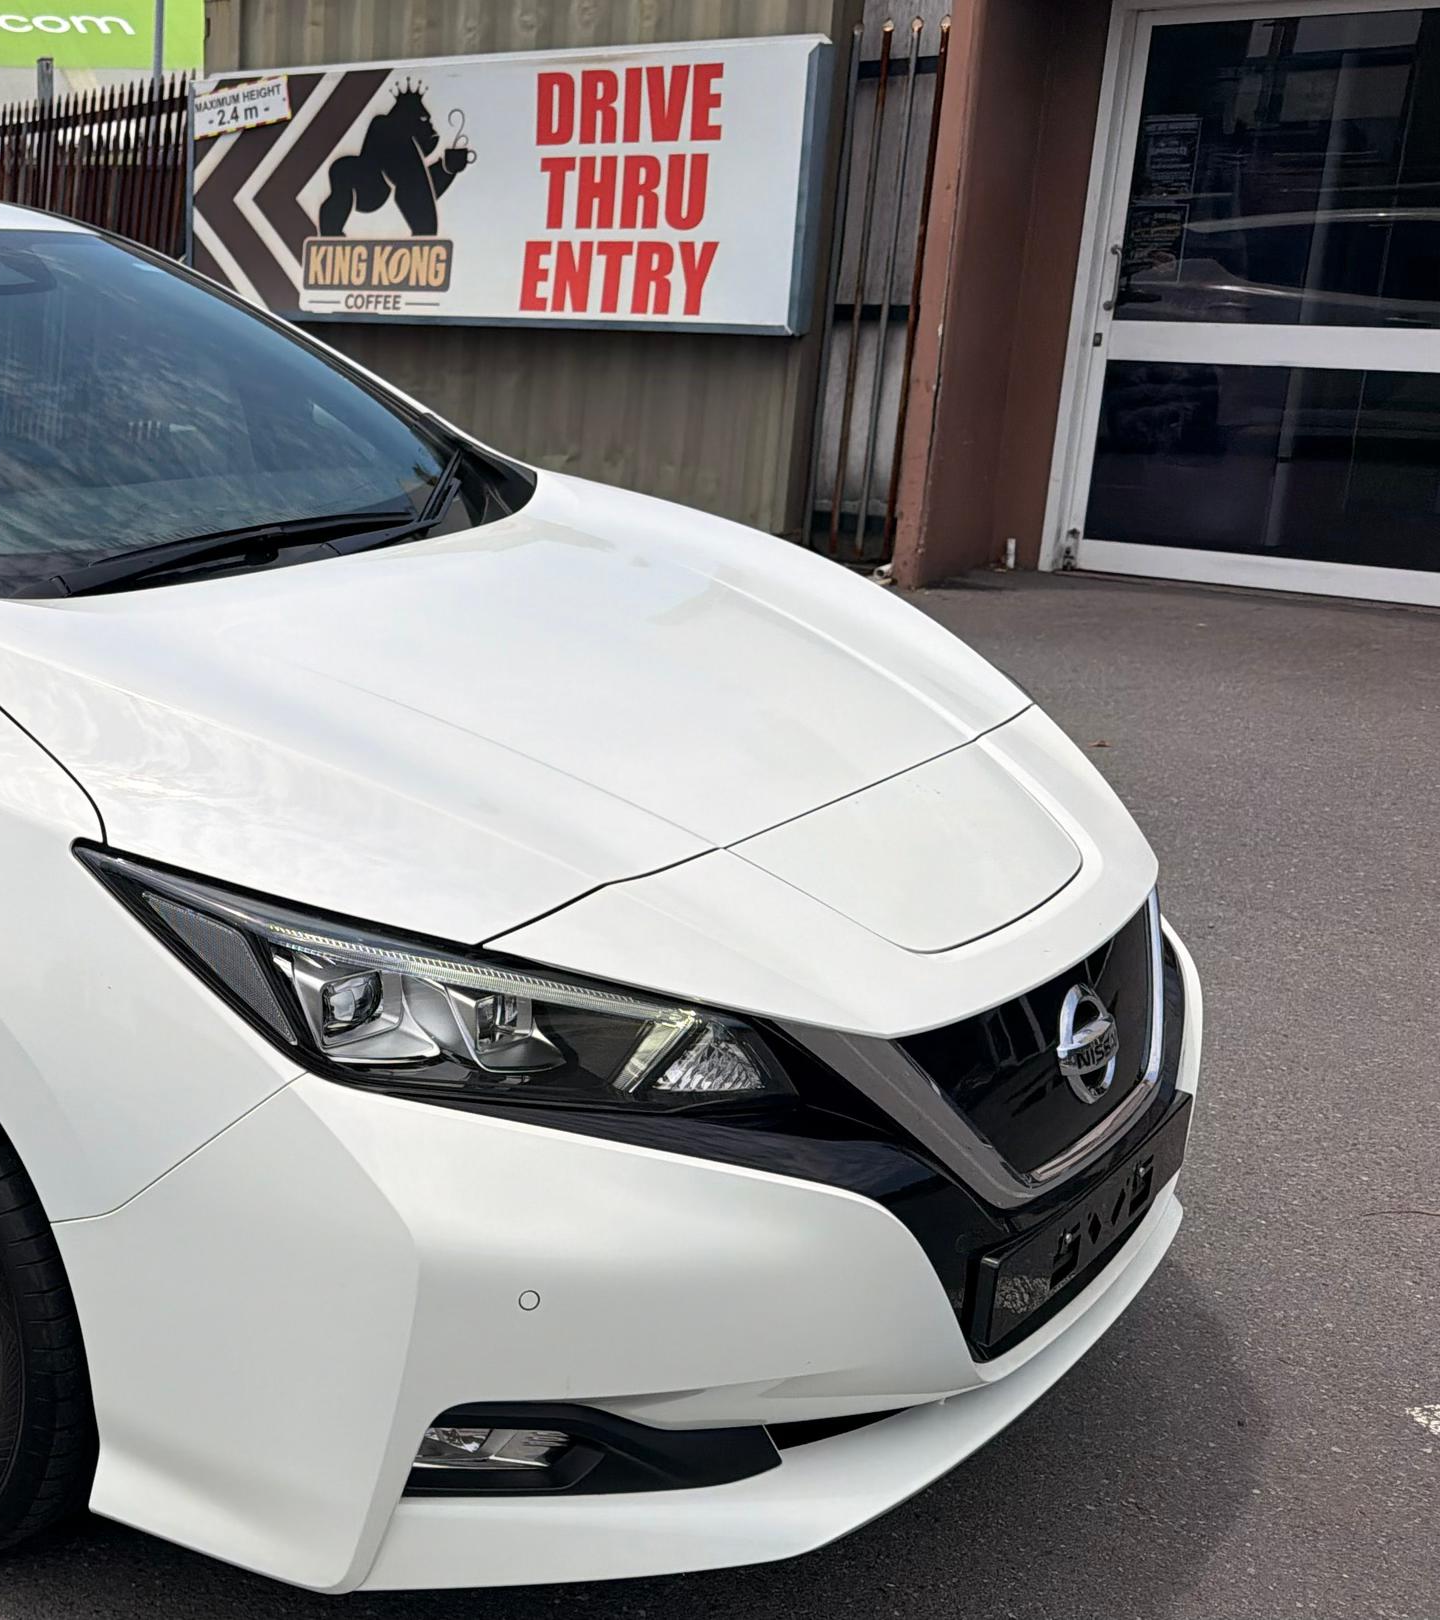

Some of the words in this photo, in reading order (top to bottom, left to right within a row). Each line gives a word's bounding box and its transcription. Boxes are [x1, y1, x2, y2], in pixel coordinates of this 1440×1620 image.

[195, 94, 240, 112] MAXIMUM
[243, 83, 281, 103] HEIGHT
[536, 63, 724, 146] DRIVE
[541, 153, 709, 230] THRU
[309, 244, 368, 286] KING
[371, 245, 447, 287] KONG
[519, 240, 720, 316] ENTRY
[345, 294, 402, 310] COFFEE
